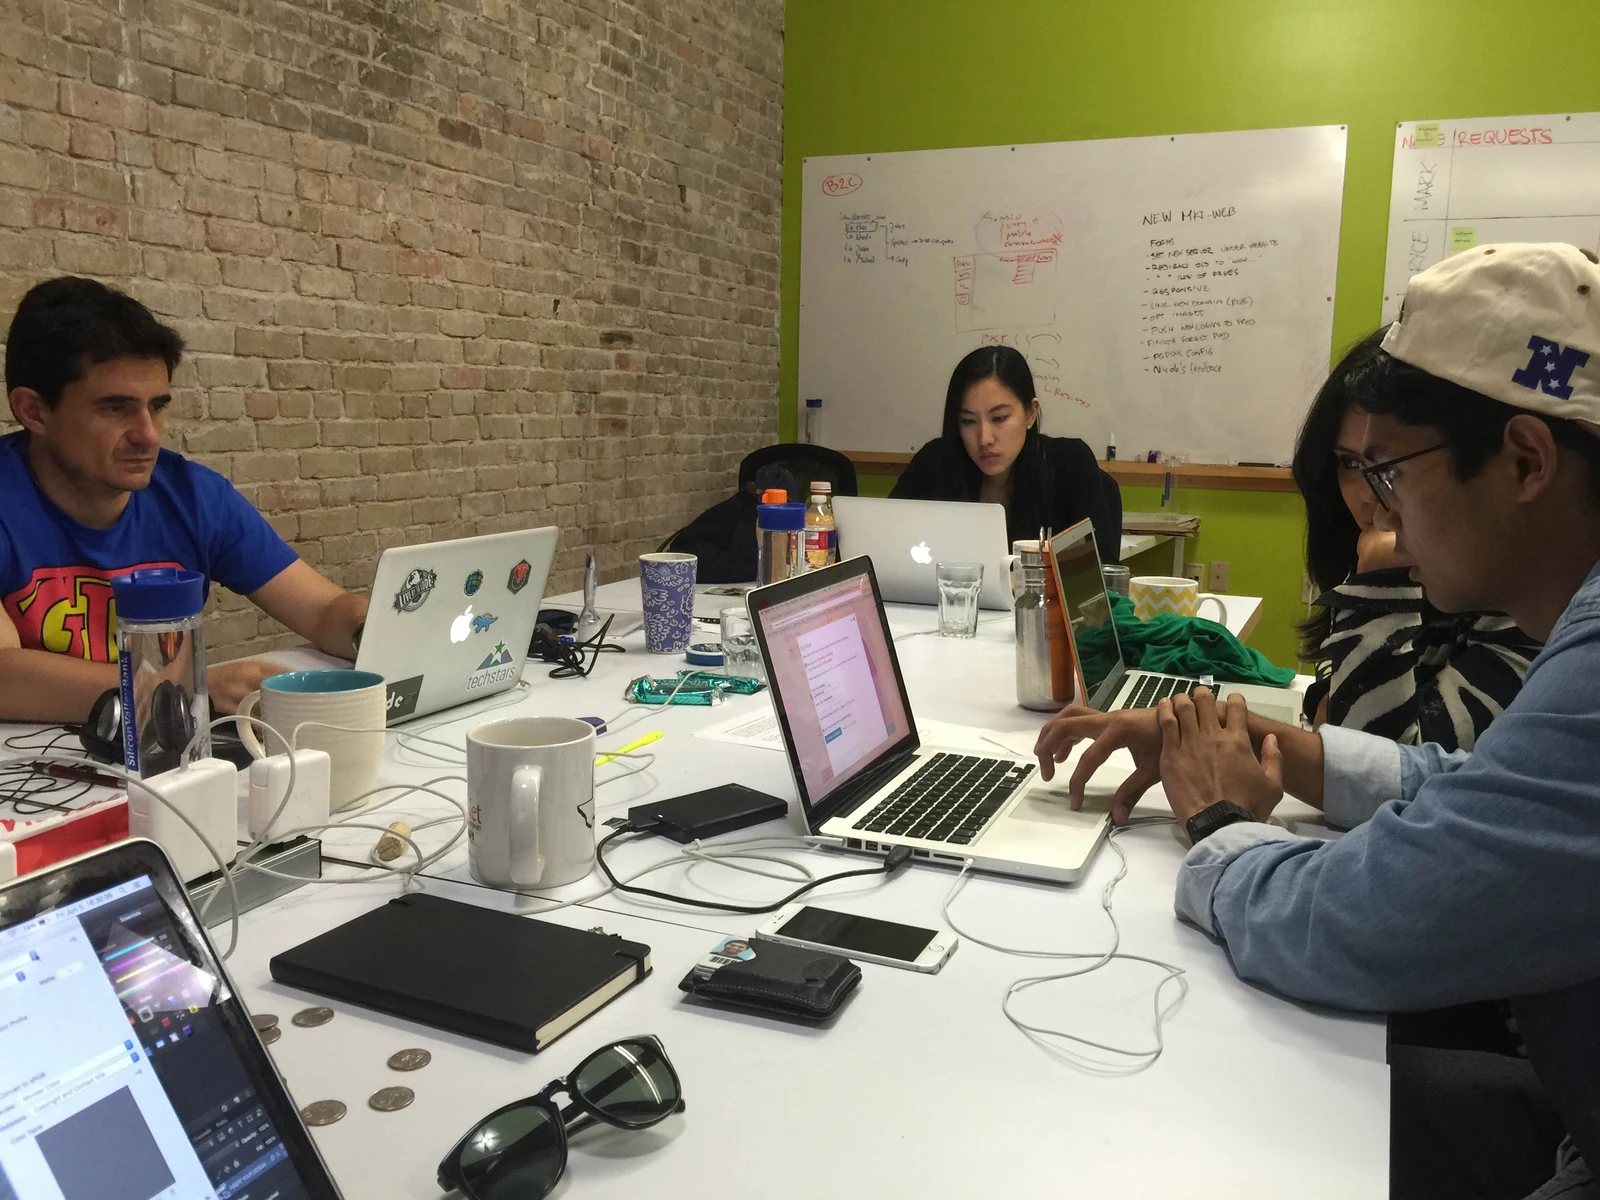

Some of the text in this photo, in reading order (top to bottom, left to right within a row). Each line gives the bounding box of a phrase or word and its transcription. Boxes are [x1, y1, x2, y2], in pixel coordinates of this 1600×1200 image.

[1402, 128, 1552, 149] NE REQUESTS
[826, 177, 857, 192] B2C
[1413, 161, 1437, 211] MARK
[1143, 211, 1172, 225] NEW
[1408, 231, 1429, 281] RYCE
[1152, 285, 1211, 296] RESPONSIVE
[1151, 326, 1174, 335] PUSH
[466, 666, 516, 690] techstars
